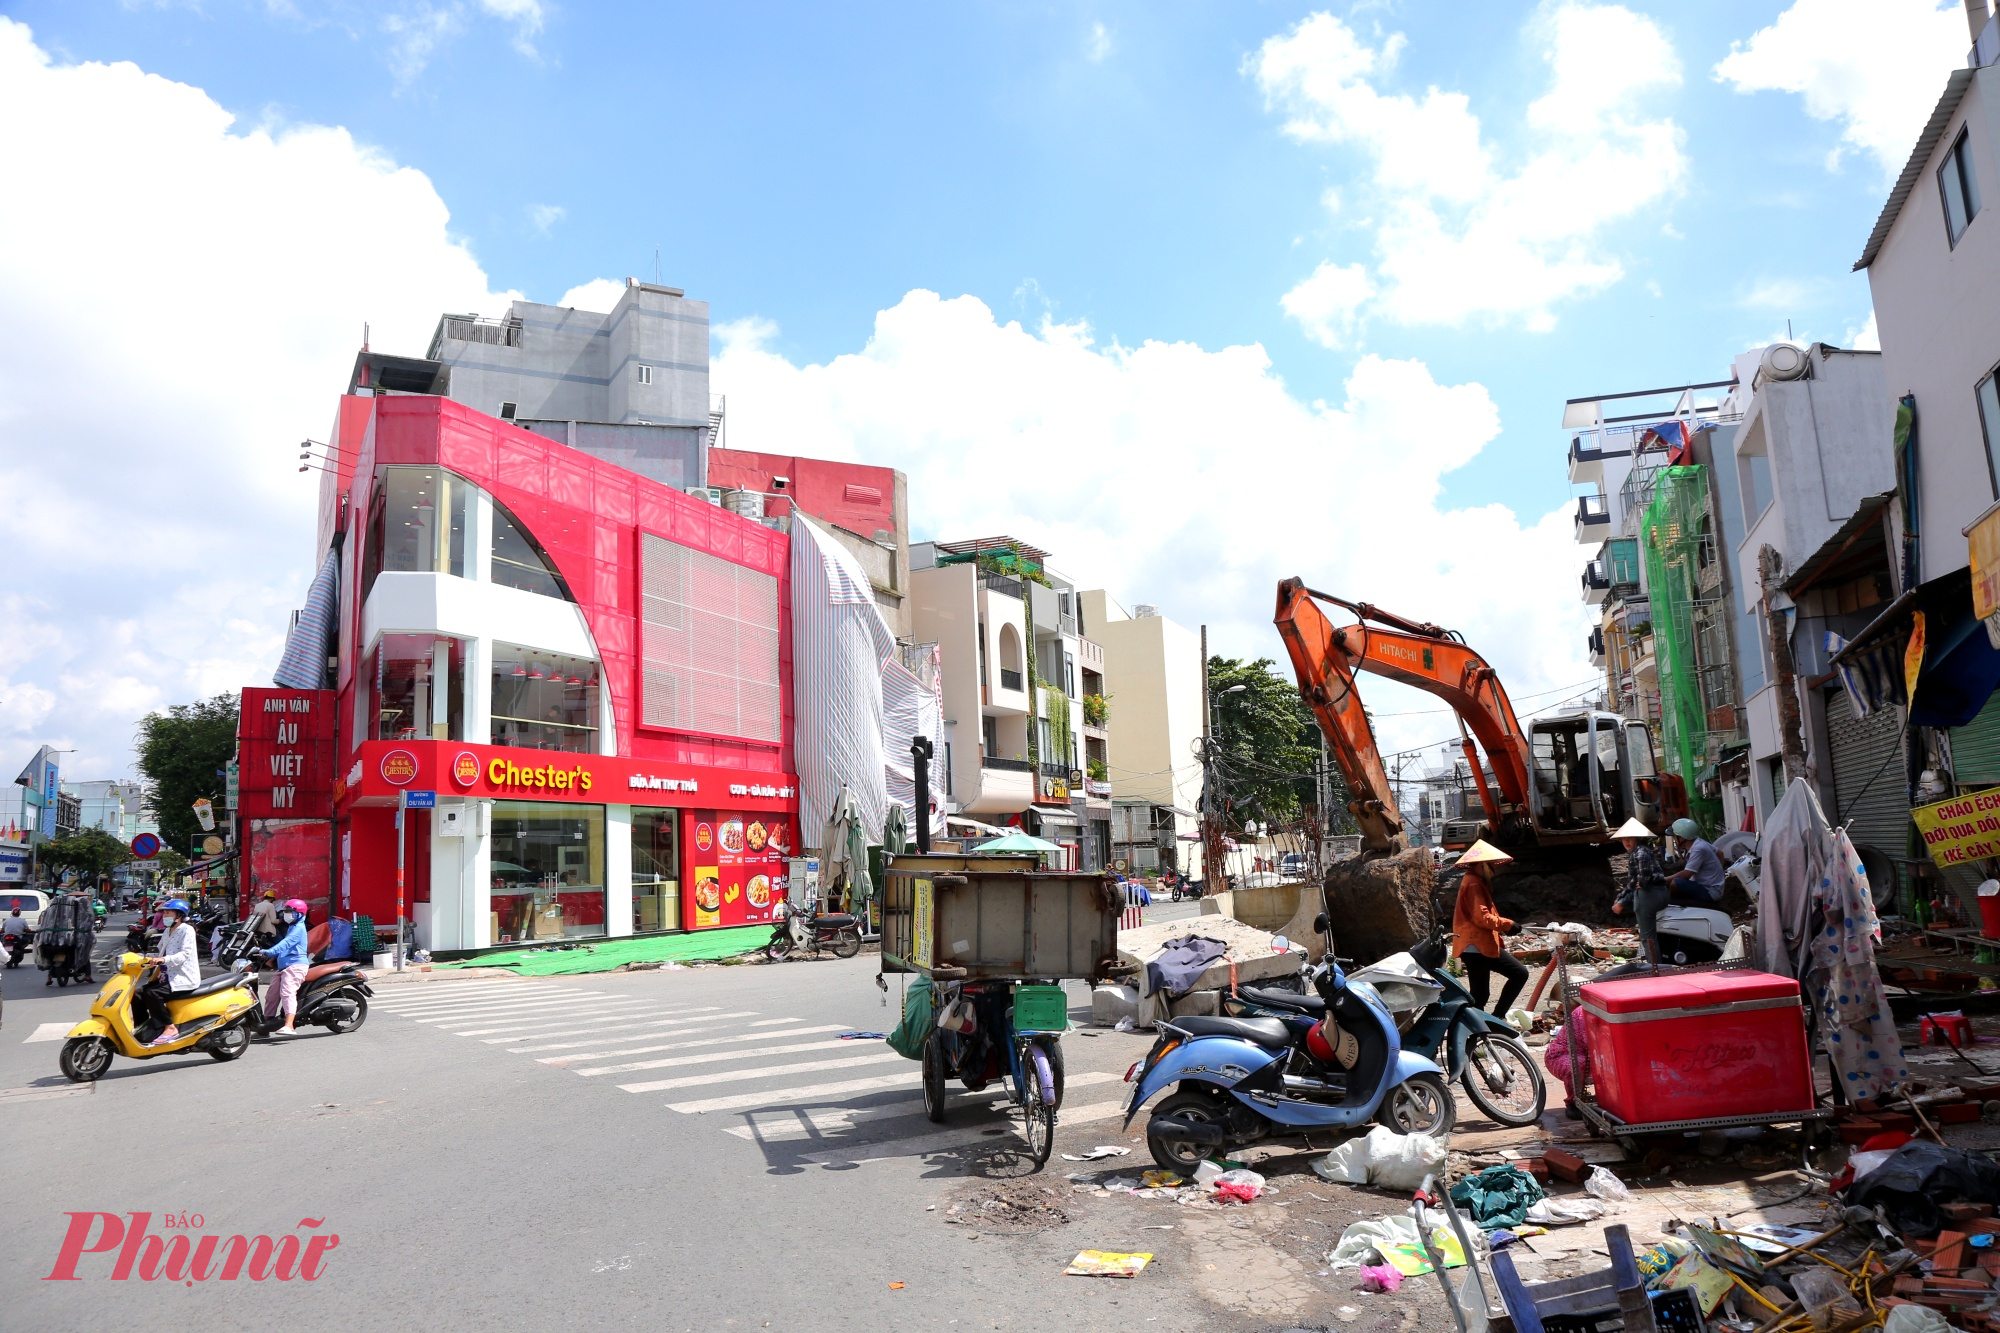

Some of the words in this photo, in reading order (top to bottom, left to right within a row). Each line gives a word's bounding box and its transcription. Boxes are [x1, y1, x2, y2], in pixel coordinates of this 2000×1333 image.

[1379, 641, 1418, 662] HITACHI
[264, 698, 286, 712] ANH
[289, 696, 310, 713] VĂN
[277, 718, 298, 744] ÂU
[270, 749, 304, 781] VIỆT
[489, 758, 592, 789] Chester's
[629, 773, 648, 788] BỮA
[272, 782, 296, 808] MỸ
[1937, 801, 1974, 820] CHÁO
[1974, 794, 2000, 812] ẾCH
[1948, 822, 1977, 840] QUA
[1966, 841, 1994, 857] CÂY
[1342, 1035, 1356, 1067] SHENG
